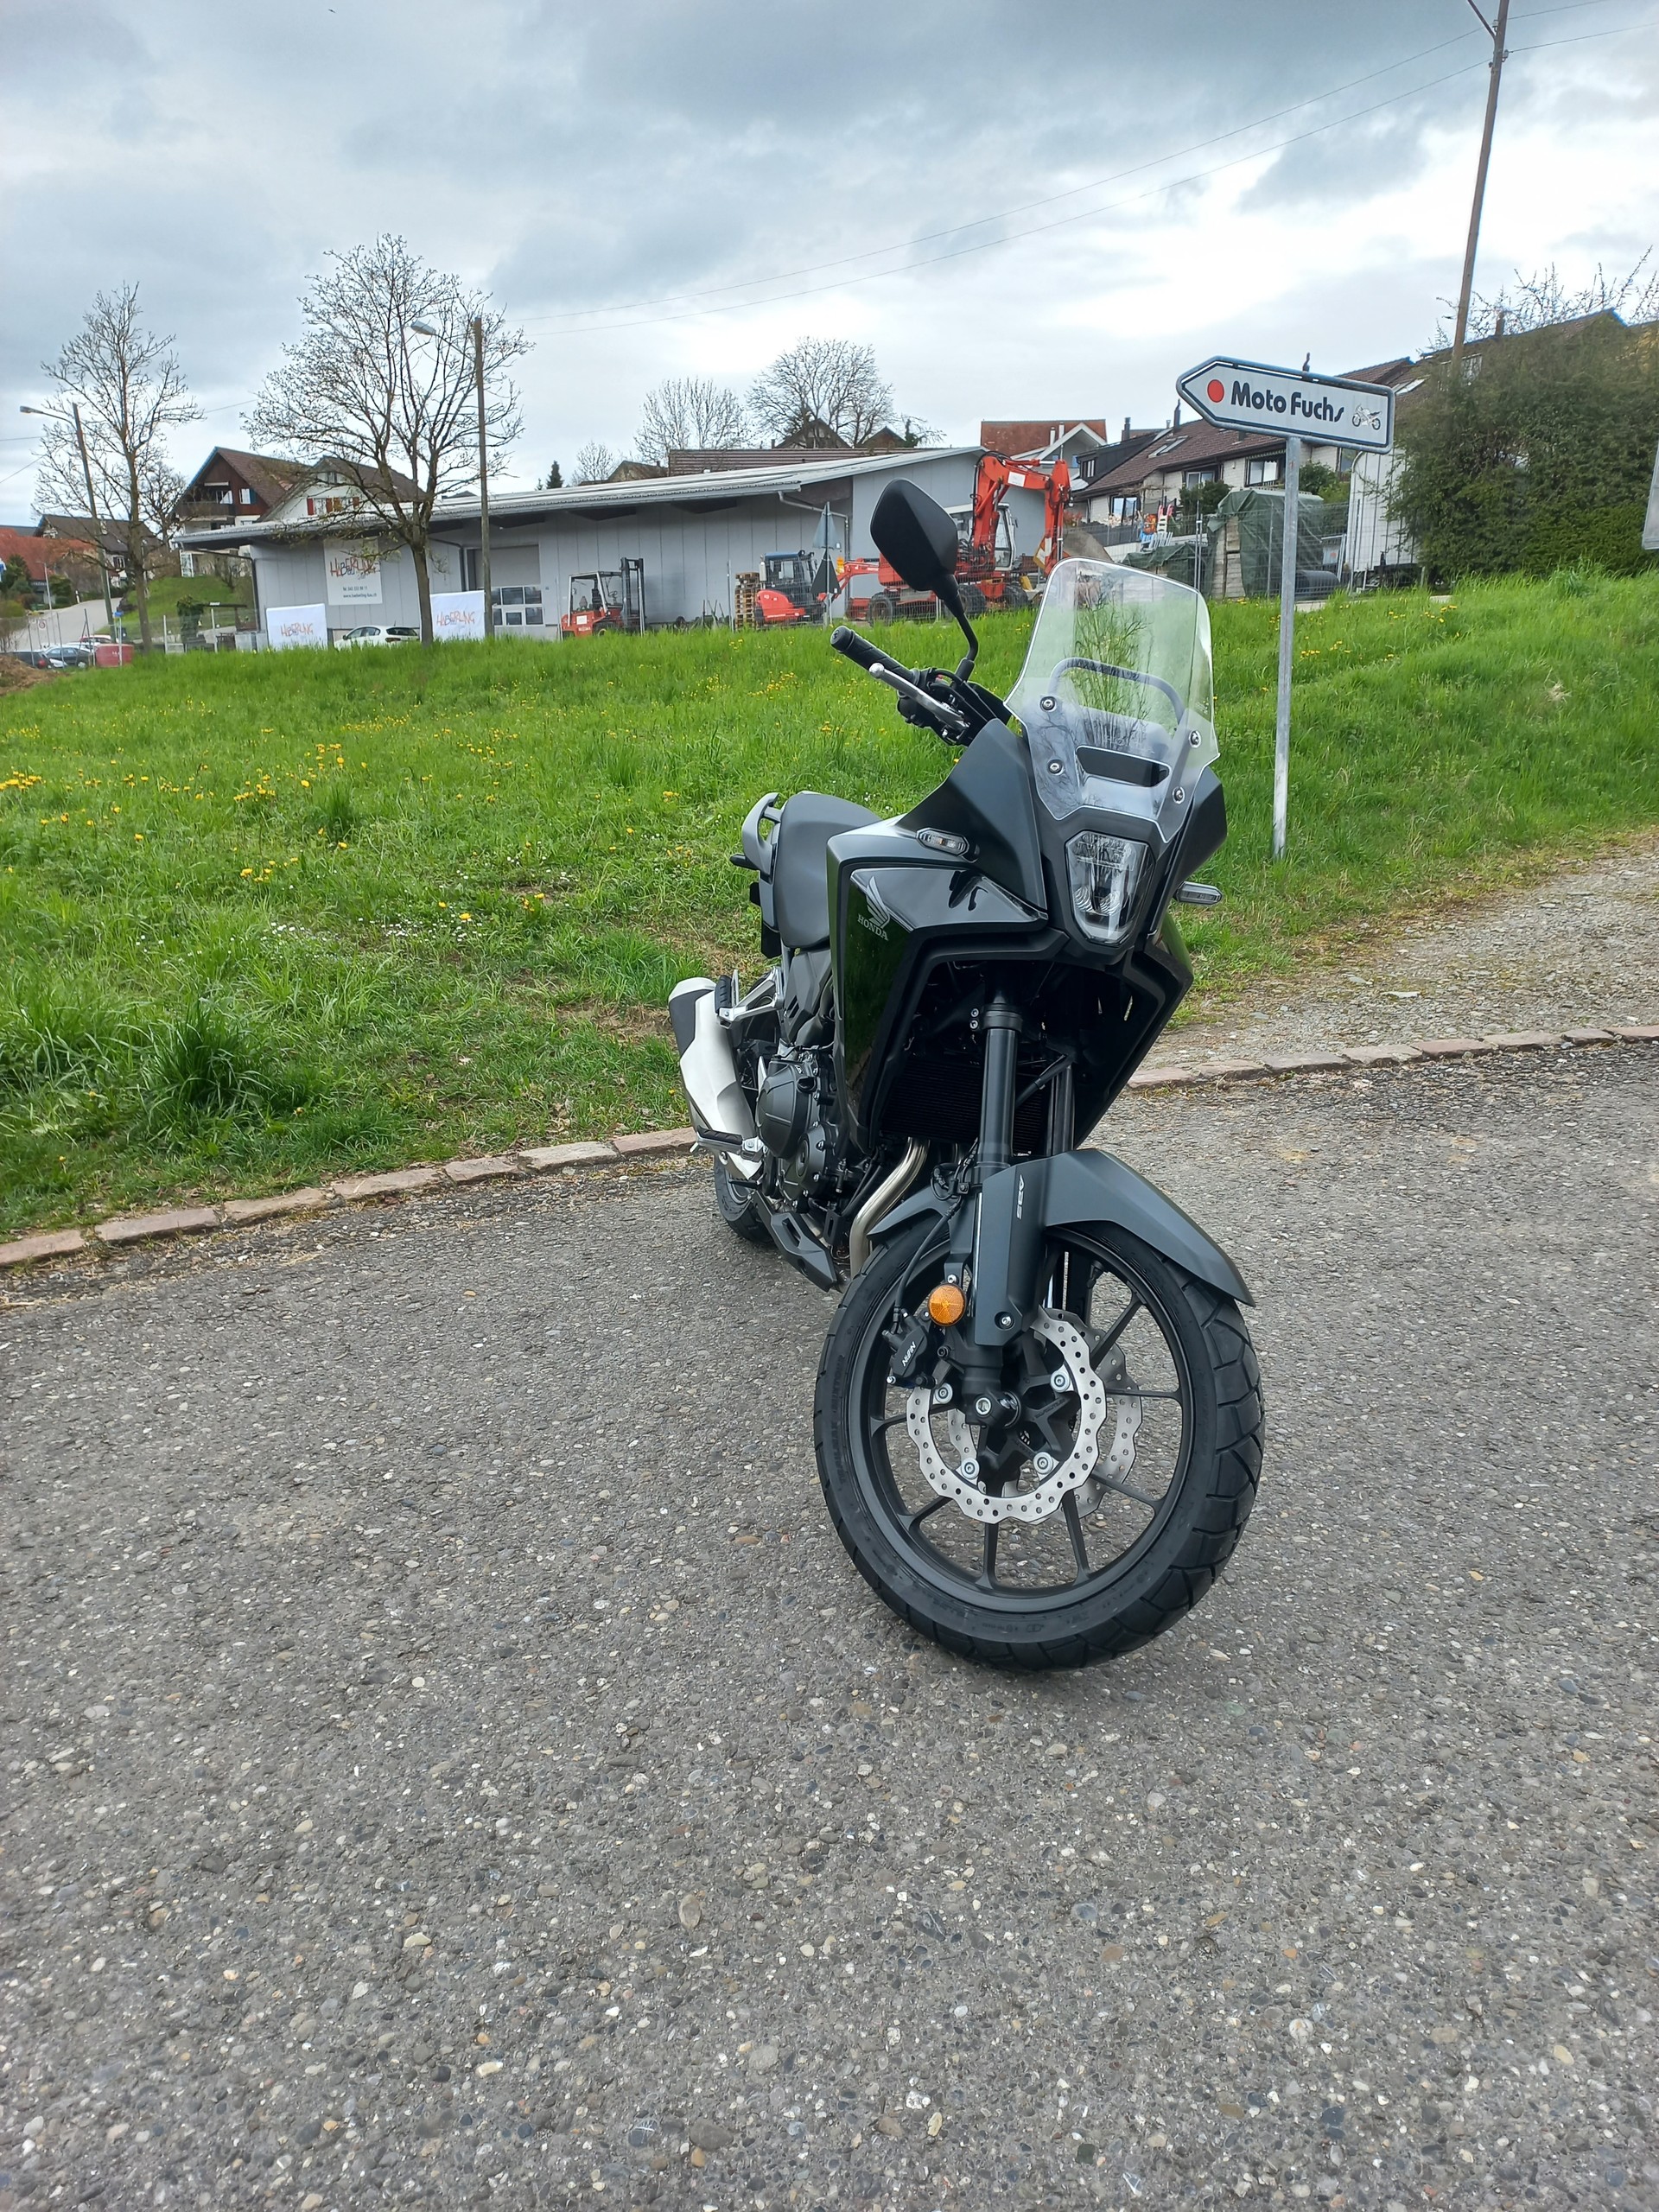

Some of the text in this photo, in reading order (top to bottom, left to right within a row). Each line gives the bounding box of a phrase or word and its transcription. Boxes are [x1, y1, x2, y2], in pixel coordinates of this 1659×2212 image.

[1230, 380, 1344, 423] Moto Fuchs
[857, 913, 889, 941] HONDA
[1016, 1174, 1025, 1220] ABS
